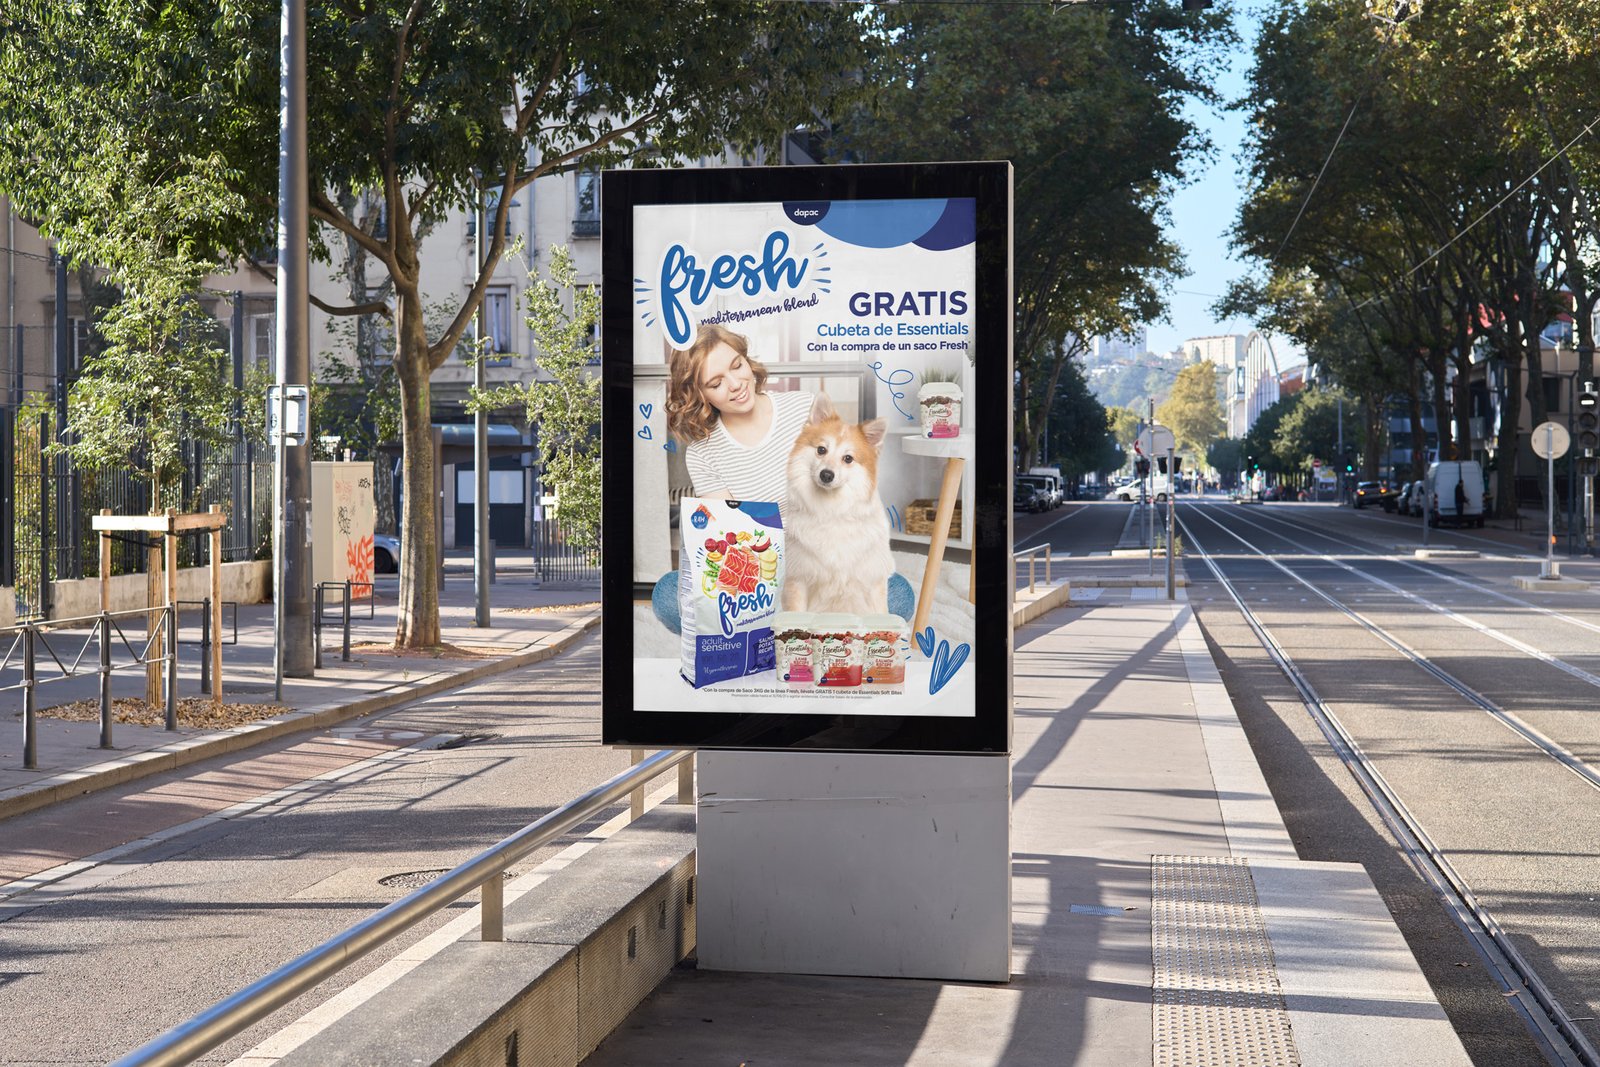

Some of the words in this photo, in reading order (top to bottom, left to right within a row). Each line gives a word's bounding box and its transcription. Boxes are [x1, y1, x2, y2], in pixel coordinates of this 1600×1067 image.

[794, 208, 818, 217] dapac
[661, 231, 808, 344] fresh
[701, 304, 782, 326] mediterranean
[784, 293, 819, 312] blend
[849, 290, 968, 316] GRATIS
[817, 324, 870, 336] Cubeta
[874, 323, 892, 336] de
[897, 322, 968, 335] Essentials
[807, 343, 827, 351] Con
[830, 342, 838, 351] la
[842, 344, 880, 352] compra
[882, 342, 895, 350] de
[719, 583, 773, 635] fresh
[702, 642, 742, 651] sensitive
